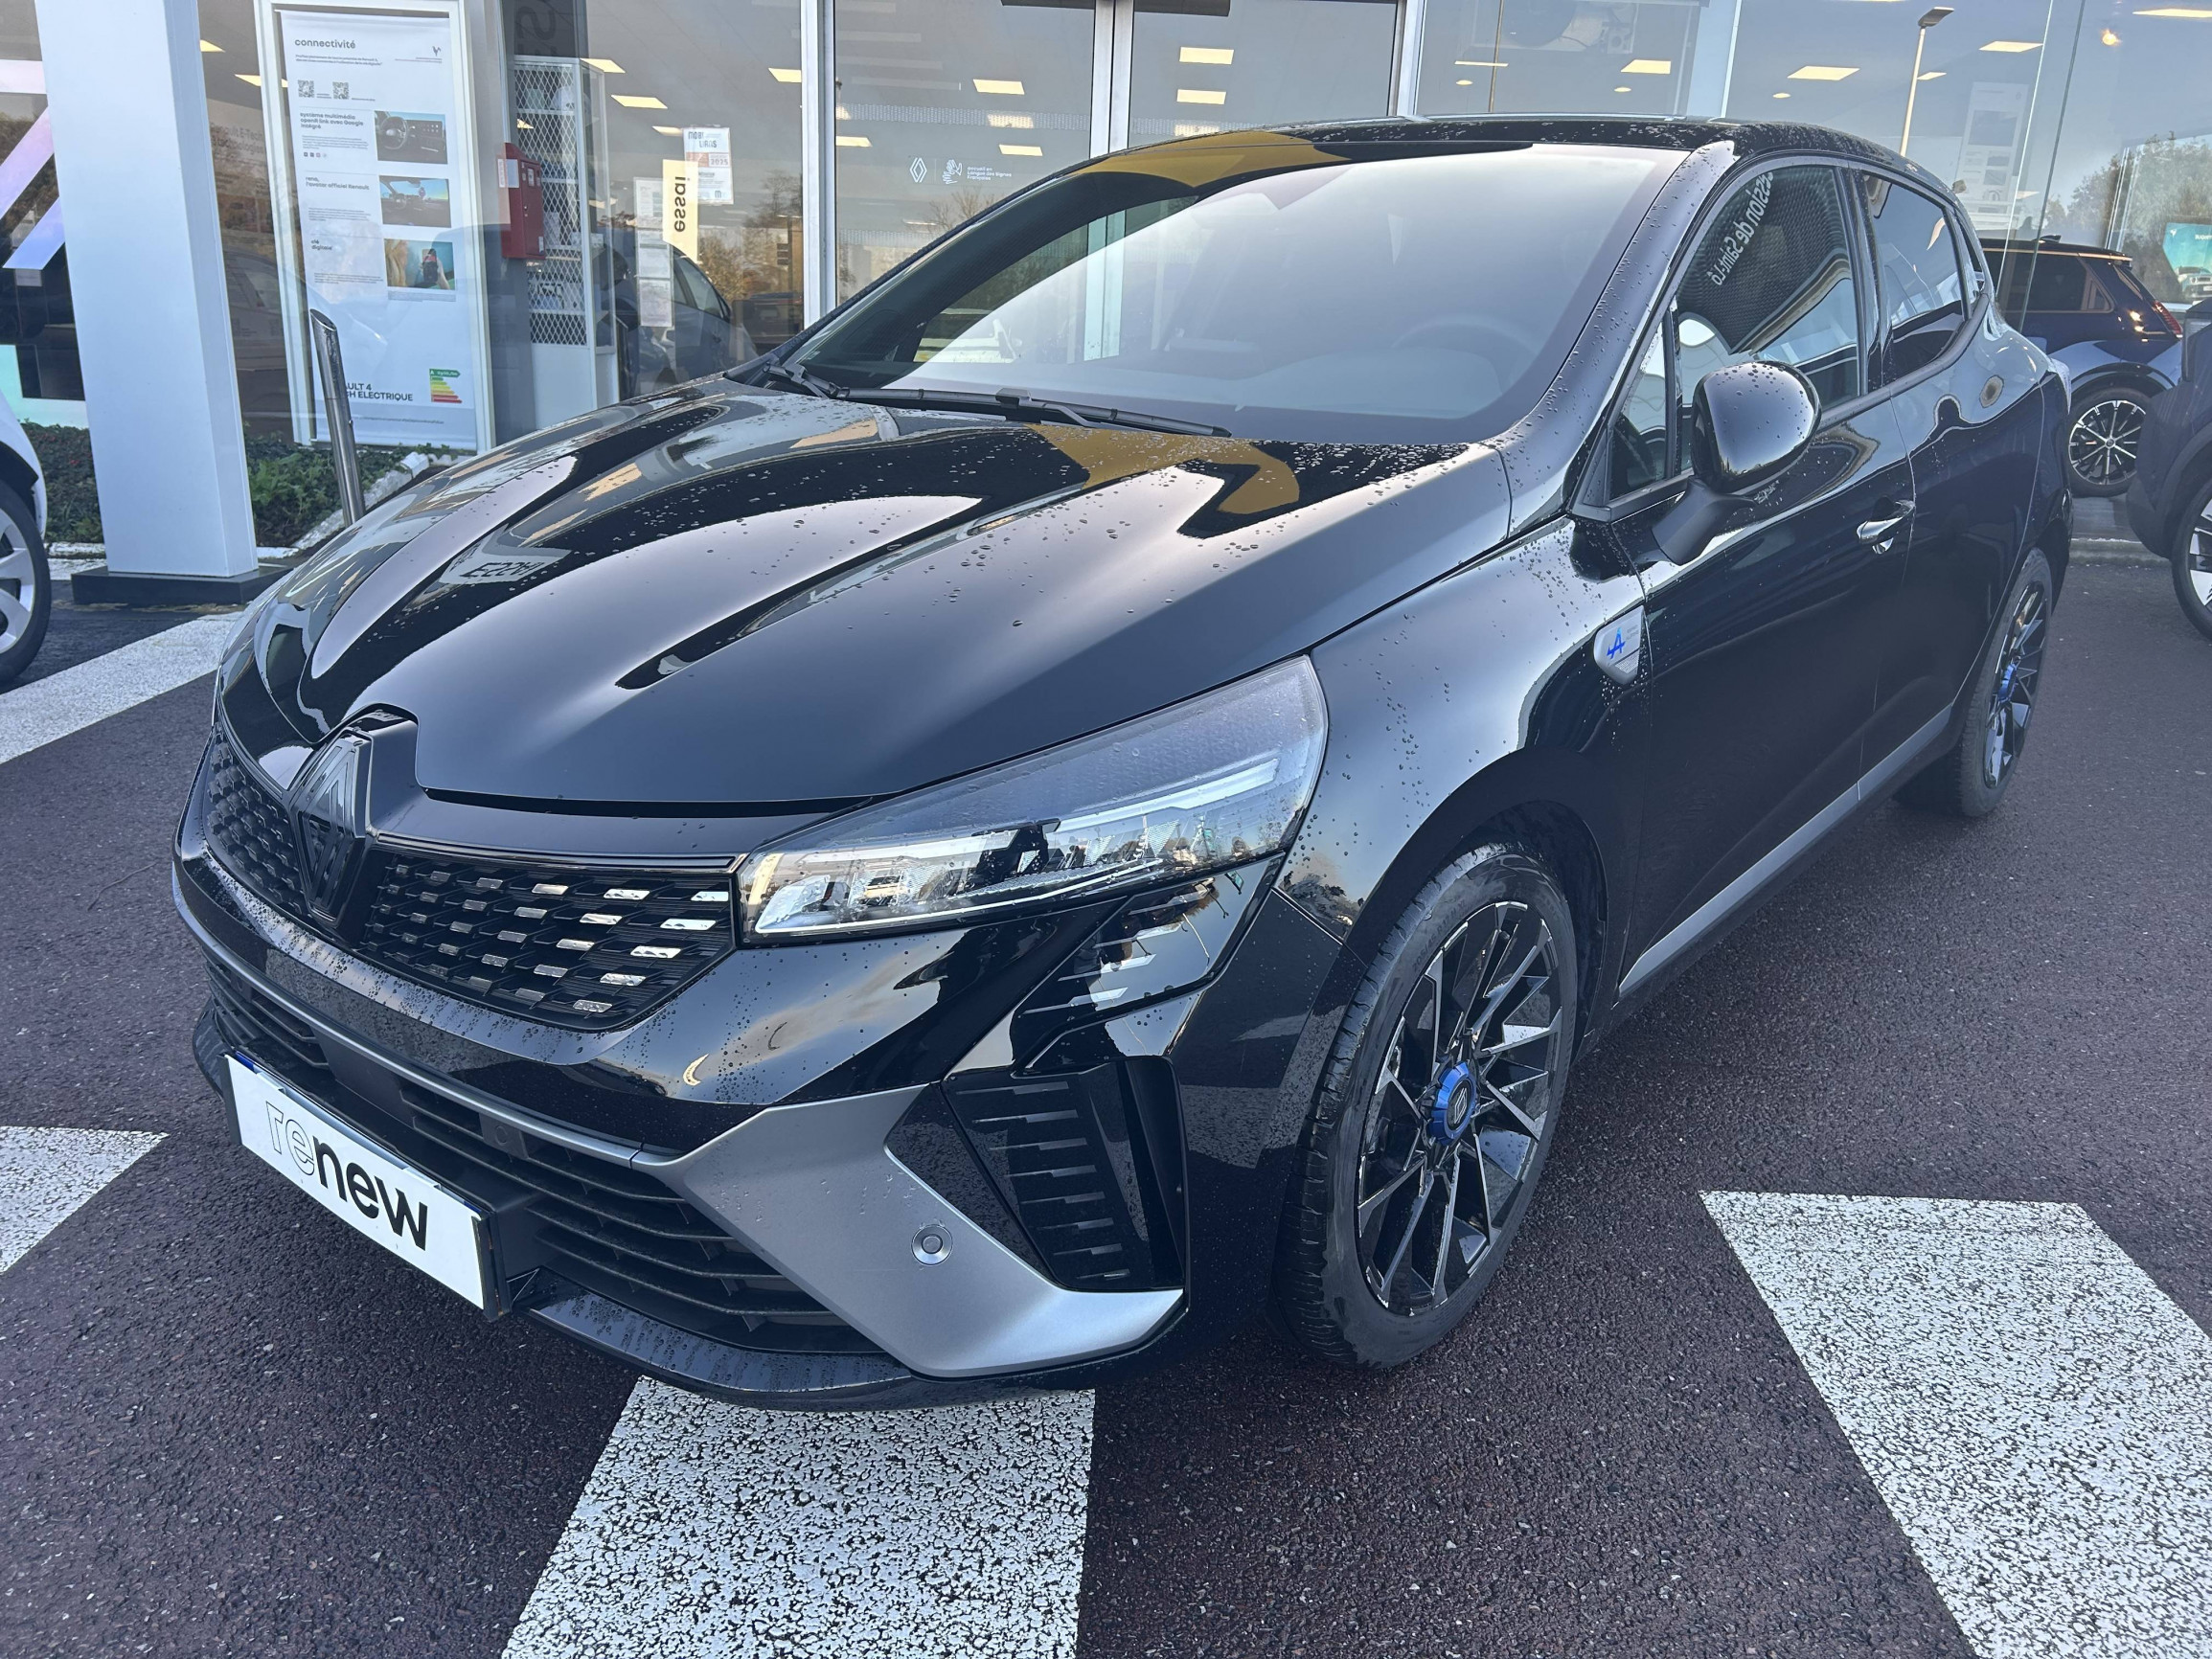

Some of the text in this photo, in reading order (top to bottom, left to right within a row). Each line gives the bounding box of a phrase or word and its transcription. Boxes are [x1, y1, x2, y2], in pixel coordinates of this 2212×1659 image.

[294, 38, 356, 49] connectivité
[357, 391, 413, 401] ELECTRIQUE
[265, 1101, 428, 1251] renew
